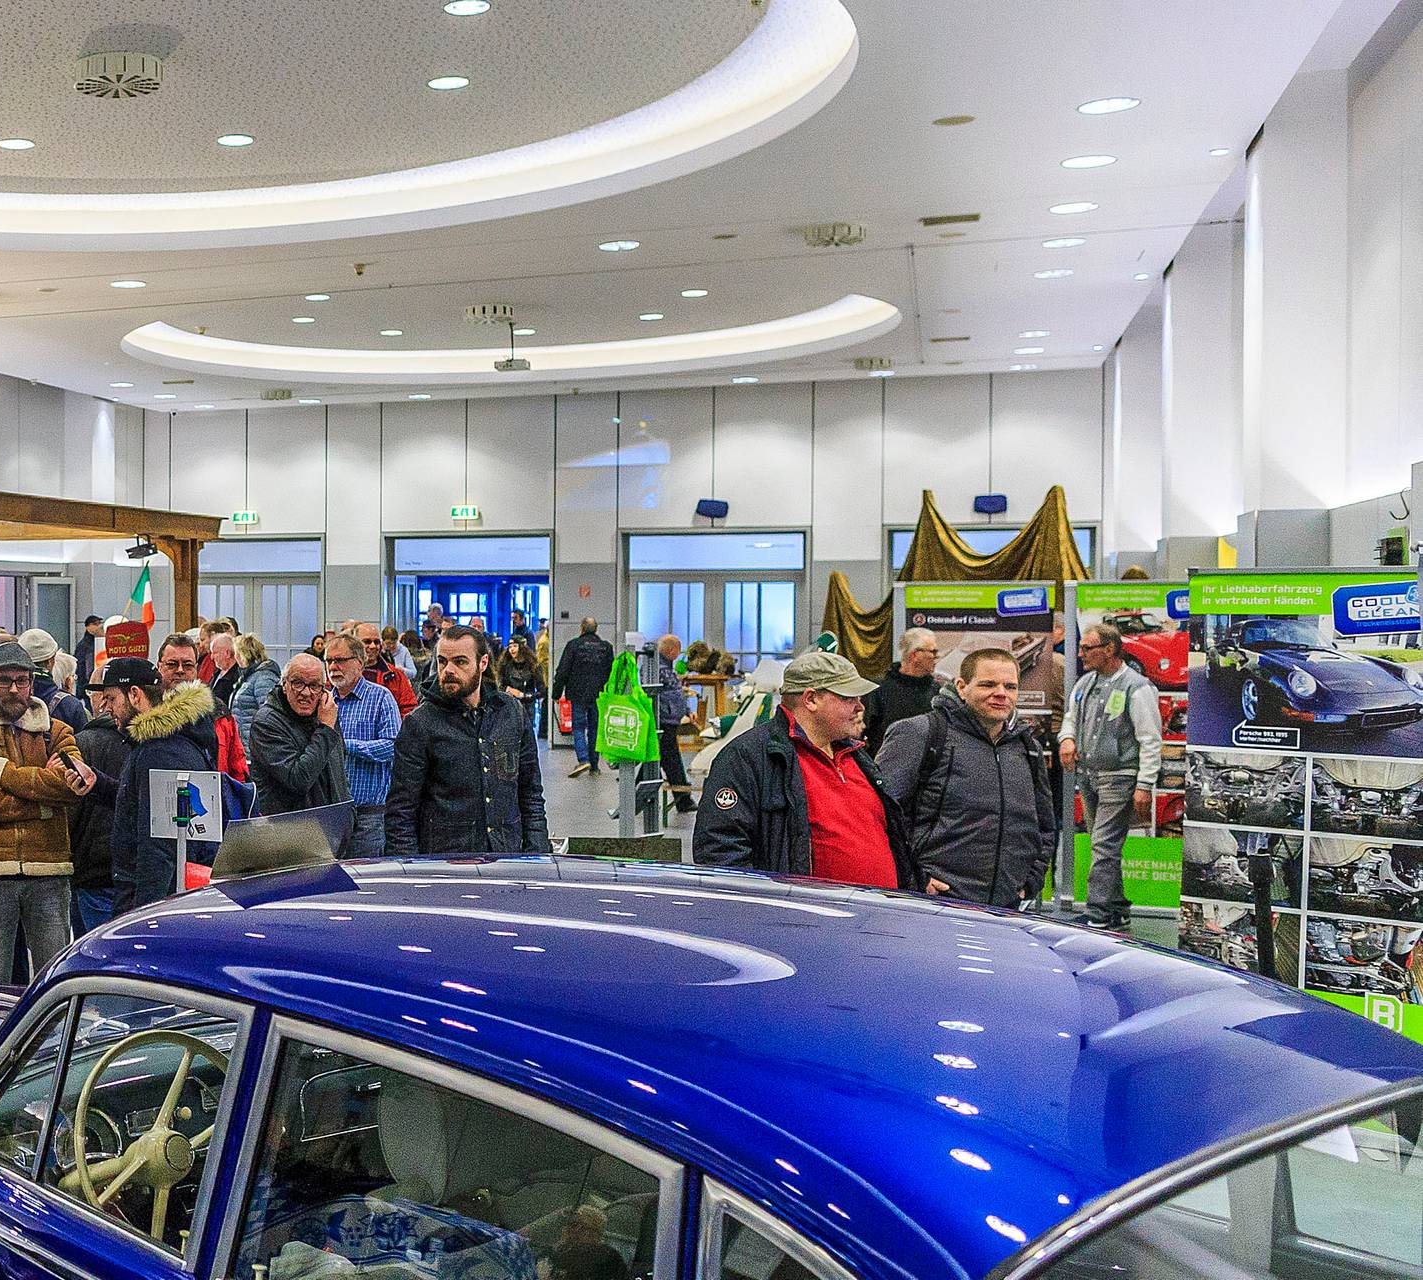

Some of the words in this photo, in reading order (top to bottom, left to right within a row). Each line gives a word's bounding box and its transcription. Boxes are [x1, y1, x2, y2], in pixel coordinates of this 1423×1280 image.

[1202, 585, 1216, 593] Ihr
[1219, 585, 1322, 595] Liebhaberfahrzeug
[1202, 596, 1211, 605] in
[1215, 596, 1270, 605] vertrauten
[1274, 596, 1317, 605] Händen.
[1352, 597, 1406, 608] COOL
[109, 646, 127, 654] MOTO
[128, 645, 147, 653] GUZZI
